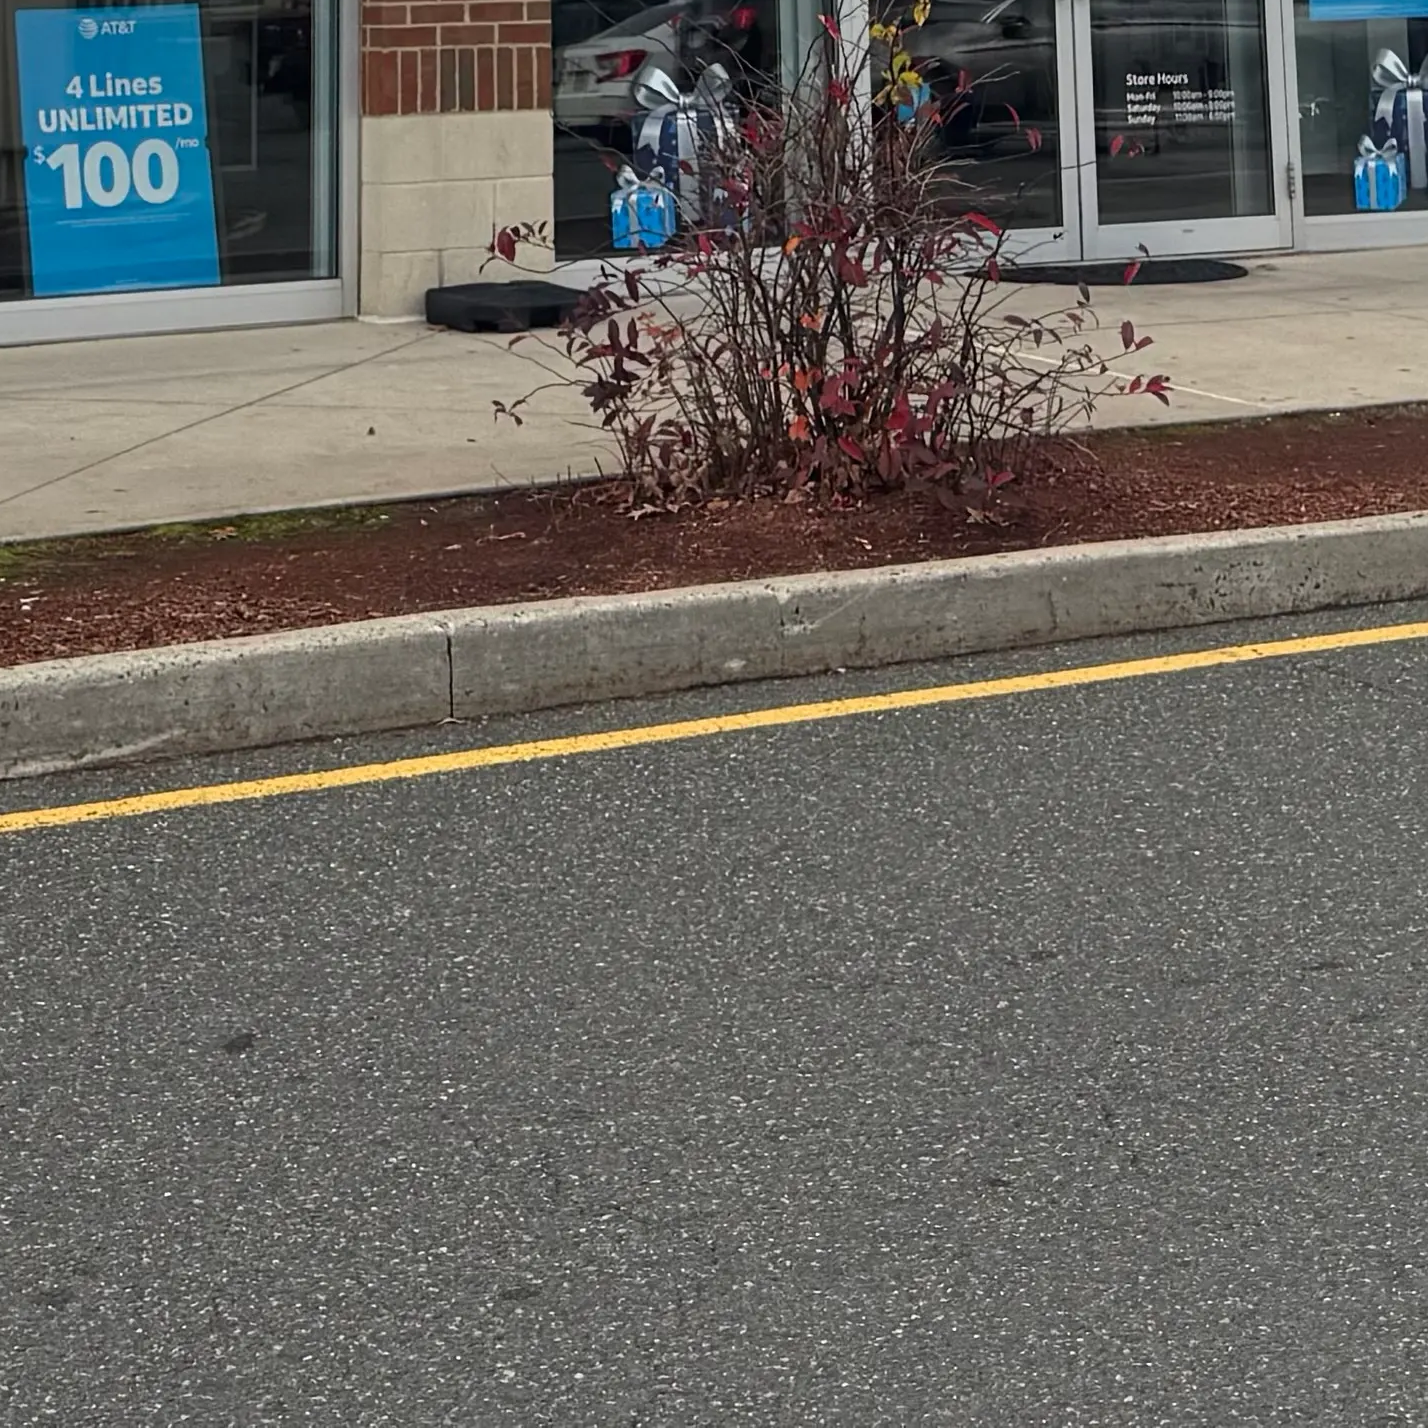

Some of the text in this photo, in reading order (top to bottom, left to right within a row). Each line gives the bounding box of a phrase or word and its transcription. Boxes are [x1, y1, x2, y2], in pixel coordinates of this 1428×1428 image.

[101, 20, 136, 35] AT&T
[65, 72, 163, 98] 4 Lines
[1126, 72, 1189, 86] Store Hours
[1127, 103, 1161, 114] Saturday
[38, 103, 193, 133] UNLIMITED
[1127, 114, 1156, 125] Sunday
